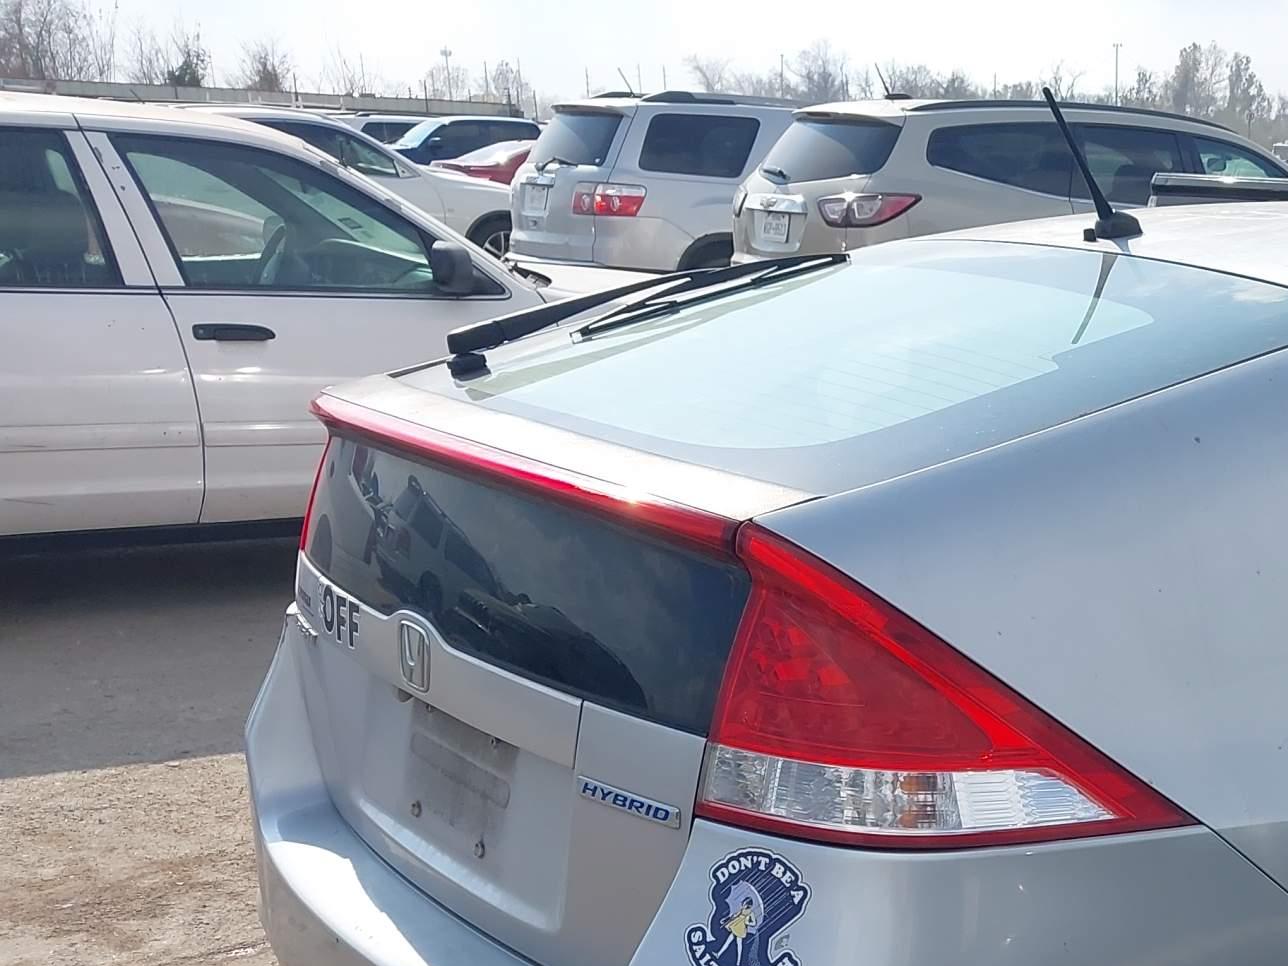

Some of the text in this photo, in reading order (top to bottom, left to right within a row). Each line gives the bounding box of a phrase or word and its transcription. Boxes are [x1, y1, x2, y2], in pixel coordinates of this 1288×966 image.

[581, 782, 671, 821] HYBRID
[715, 855, 804, 905] DON'T BE A
